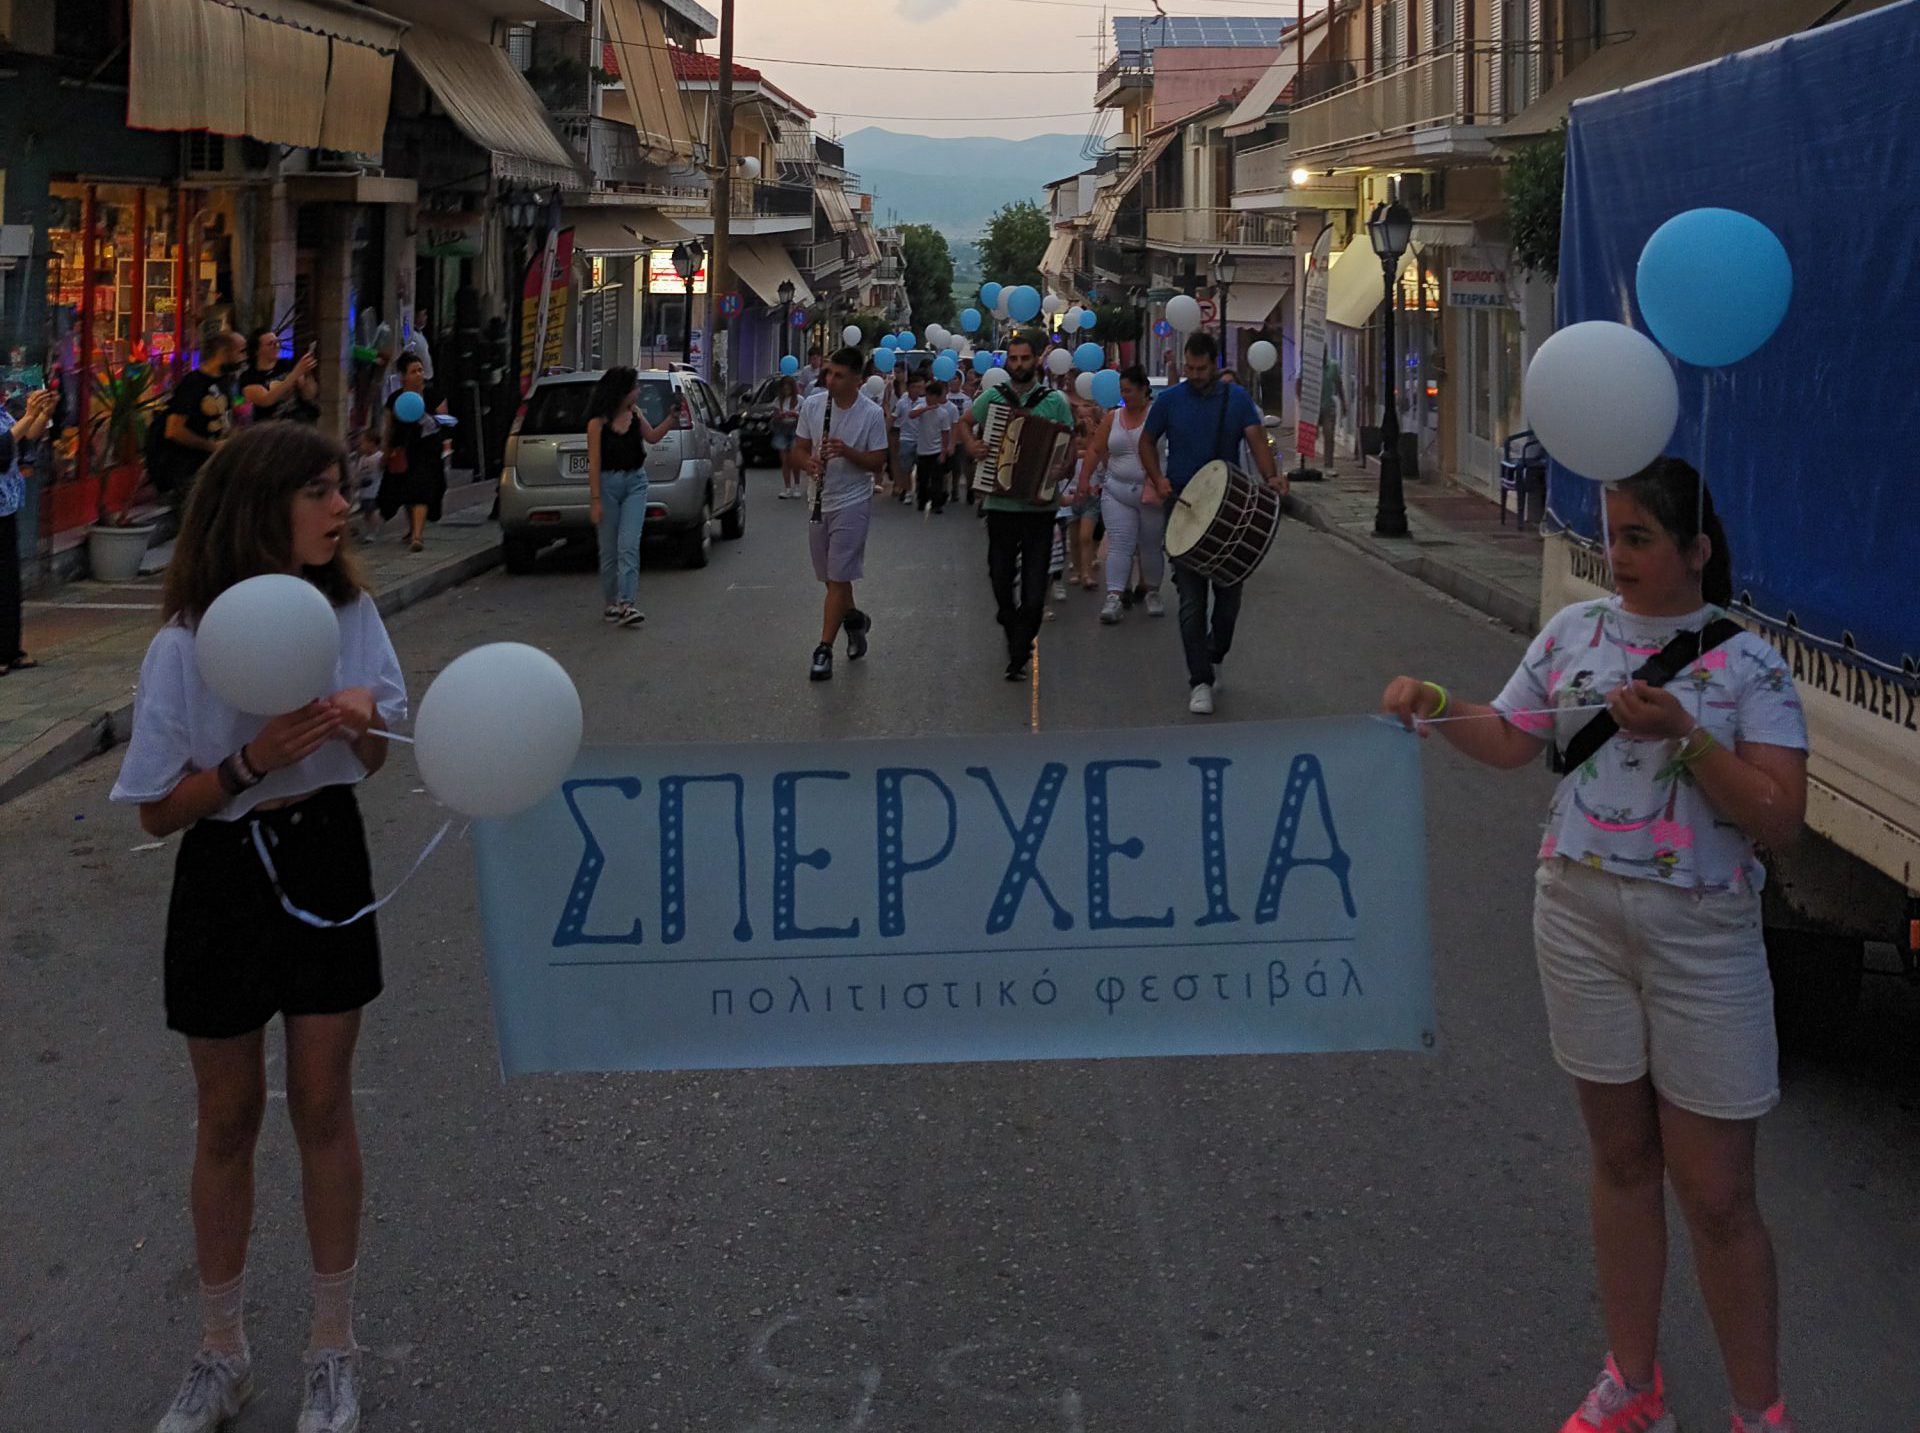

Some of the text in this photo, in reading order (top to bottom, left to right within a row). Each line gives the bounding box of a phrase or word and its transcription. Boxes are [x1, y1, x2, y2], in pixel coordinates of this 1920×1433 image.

[1760, 625, 1917, 731] ΚΑΤΑΣΤΑΣΕΙΣ
[552, 754, 1357, 947] ΣΠΕΡΧΕΙΑ
[712, 957, 1364, 1016] πολιτιστικό φεστιβάλ
